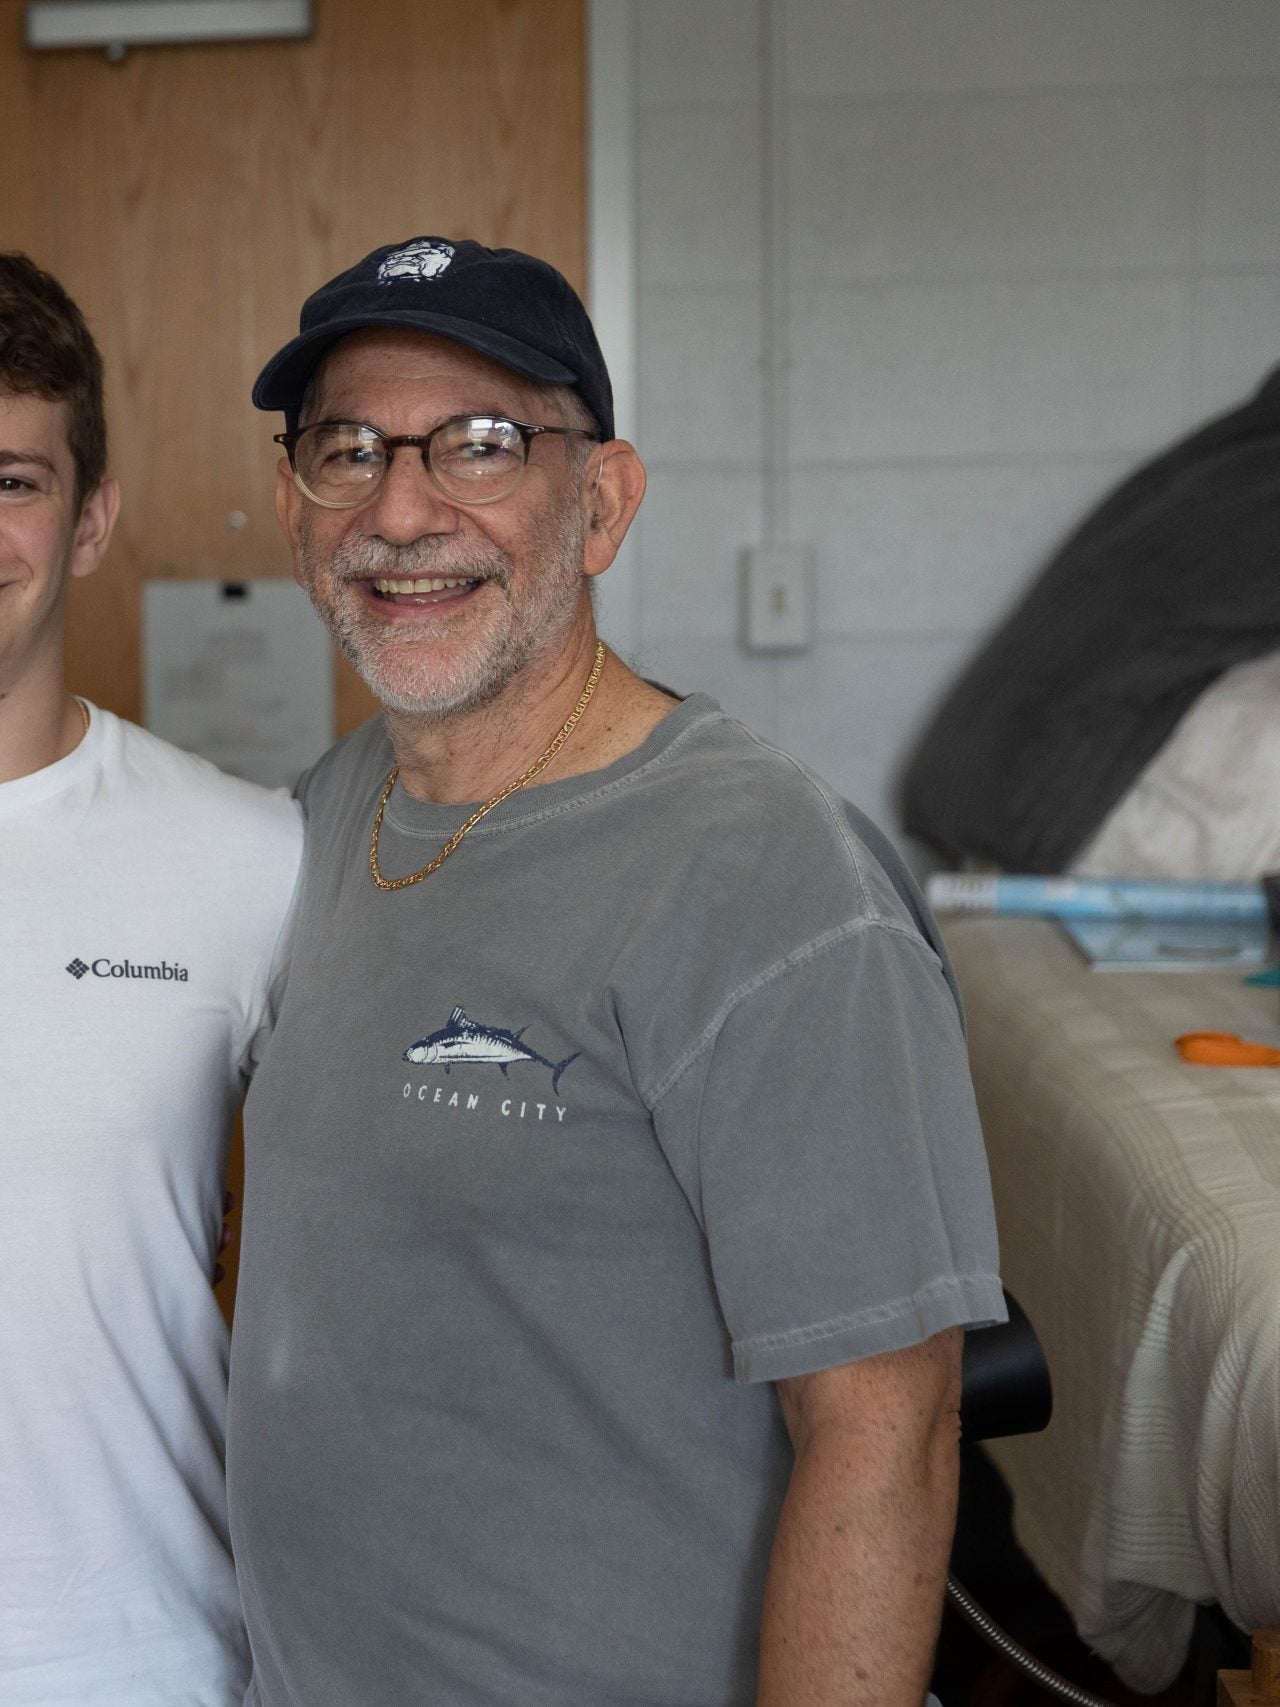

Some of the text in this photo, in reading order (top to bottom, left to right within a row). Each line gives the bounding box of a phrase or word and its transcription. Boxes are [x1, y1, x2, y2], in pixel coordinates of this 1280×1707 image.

[91, 958, 188, 982] Columbia
[403, 1083, 566, 1122] OCEAN CITY
